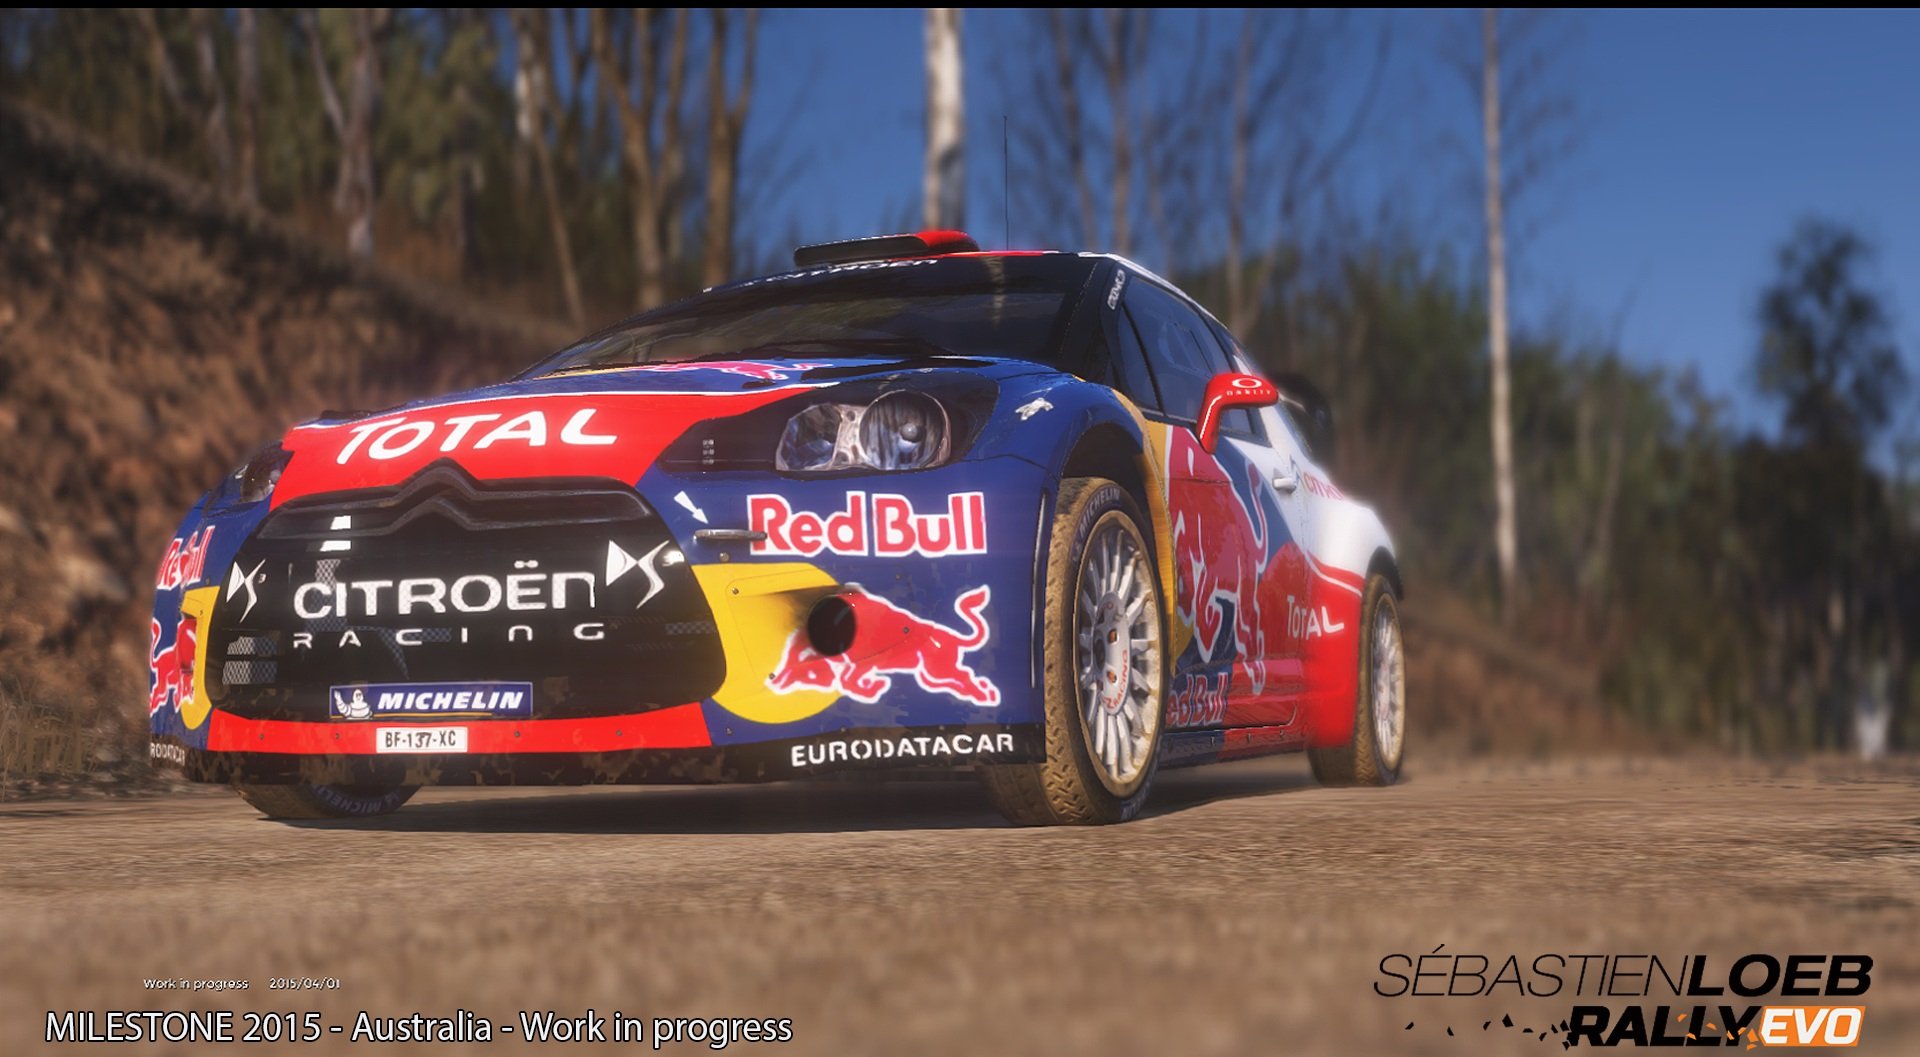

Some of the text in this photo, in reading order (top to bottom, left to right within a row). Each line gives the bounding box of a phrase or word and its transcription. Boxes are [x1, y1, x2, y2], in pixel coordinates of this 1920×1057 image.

[335, 408, 618, 465] TOTAL
[747, 491, 988, 558] Red Bull
[1079, 487, 1121, 538] MICHELIN
[293, 622, 606, 650] RACING
[1287, 594, 1345, 641] TOTAL
[377, 691, 524, 710] MICHELIN
[1165, 671, 1229, 728] ed Bull
[385, 731, 457, 749] BF-137-XC
[790, 733, 1015, 767] EURODATACAR
